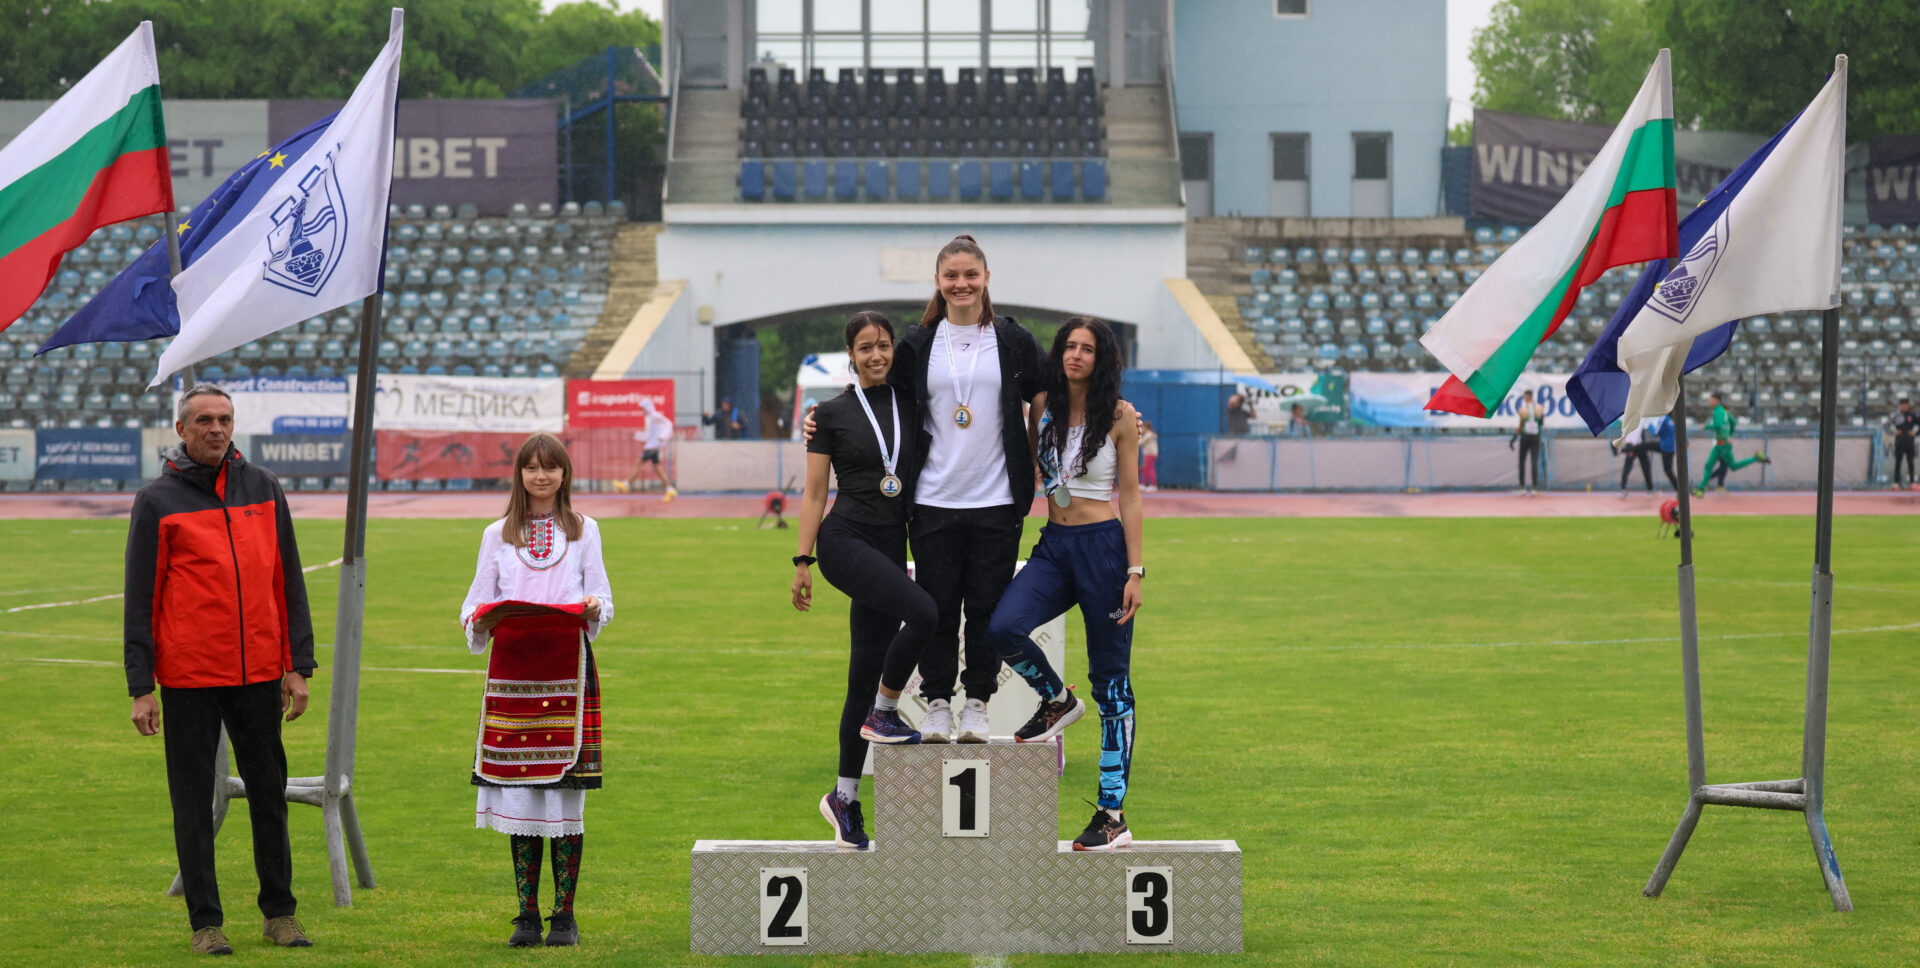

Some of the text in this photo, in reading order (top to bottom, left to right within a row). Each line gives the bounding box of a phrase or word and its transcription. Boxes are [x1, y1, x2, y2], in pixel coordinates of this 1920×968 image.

[393, 138, 507, 178] BET
[257, 377, 346, 392] Construction
[414, 393, 539, 419] МЕДИКА
[262, 443, 344, 461] WINBET
[949, 767, 977, 831] 1
[767, 875, 803, 938] 2
[1132, 872, 1168, 937] 3
